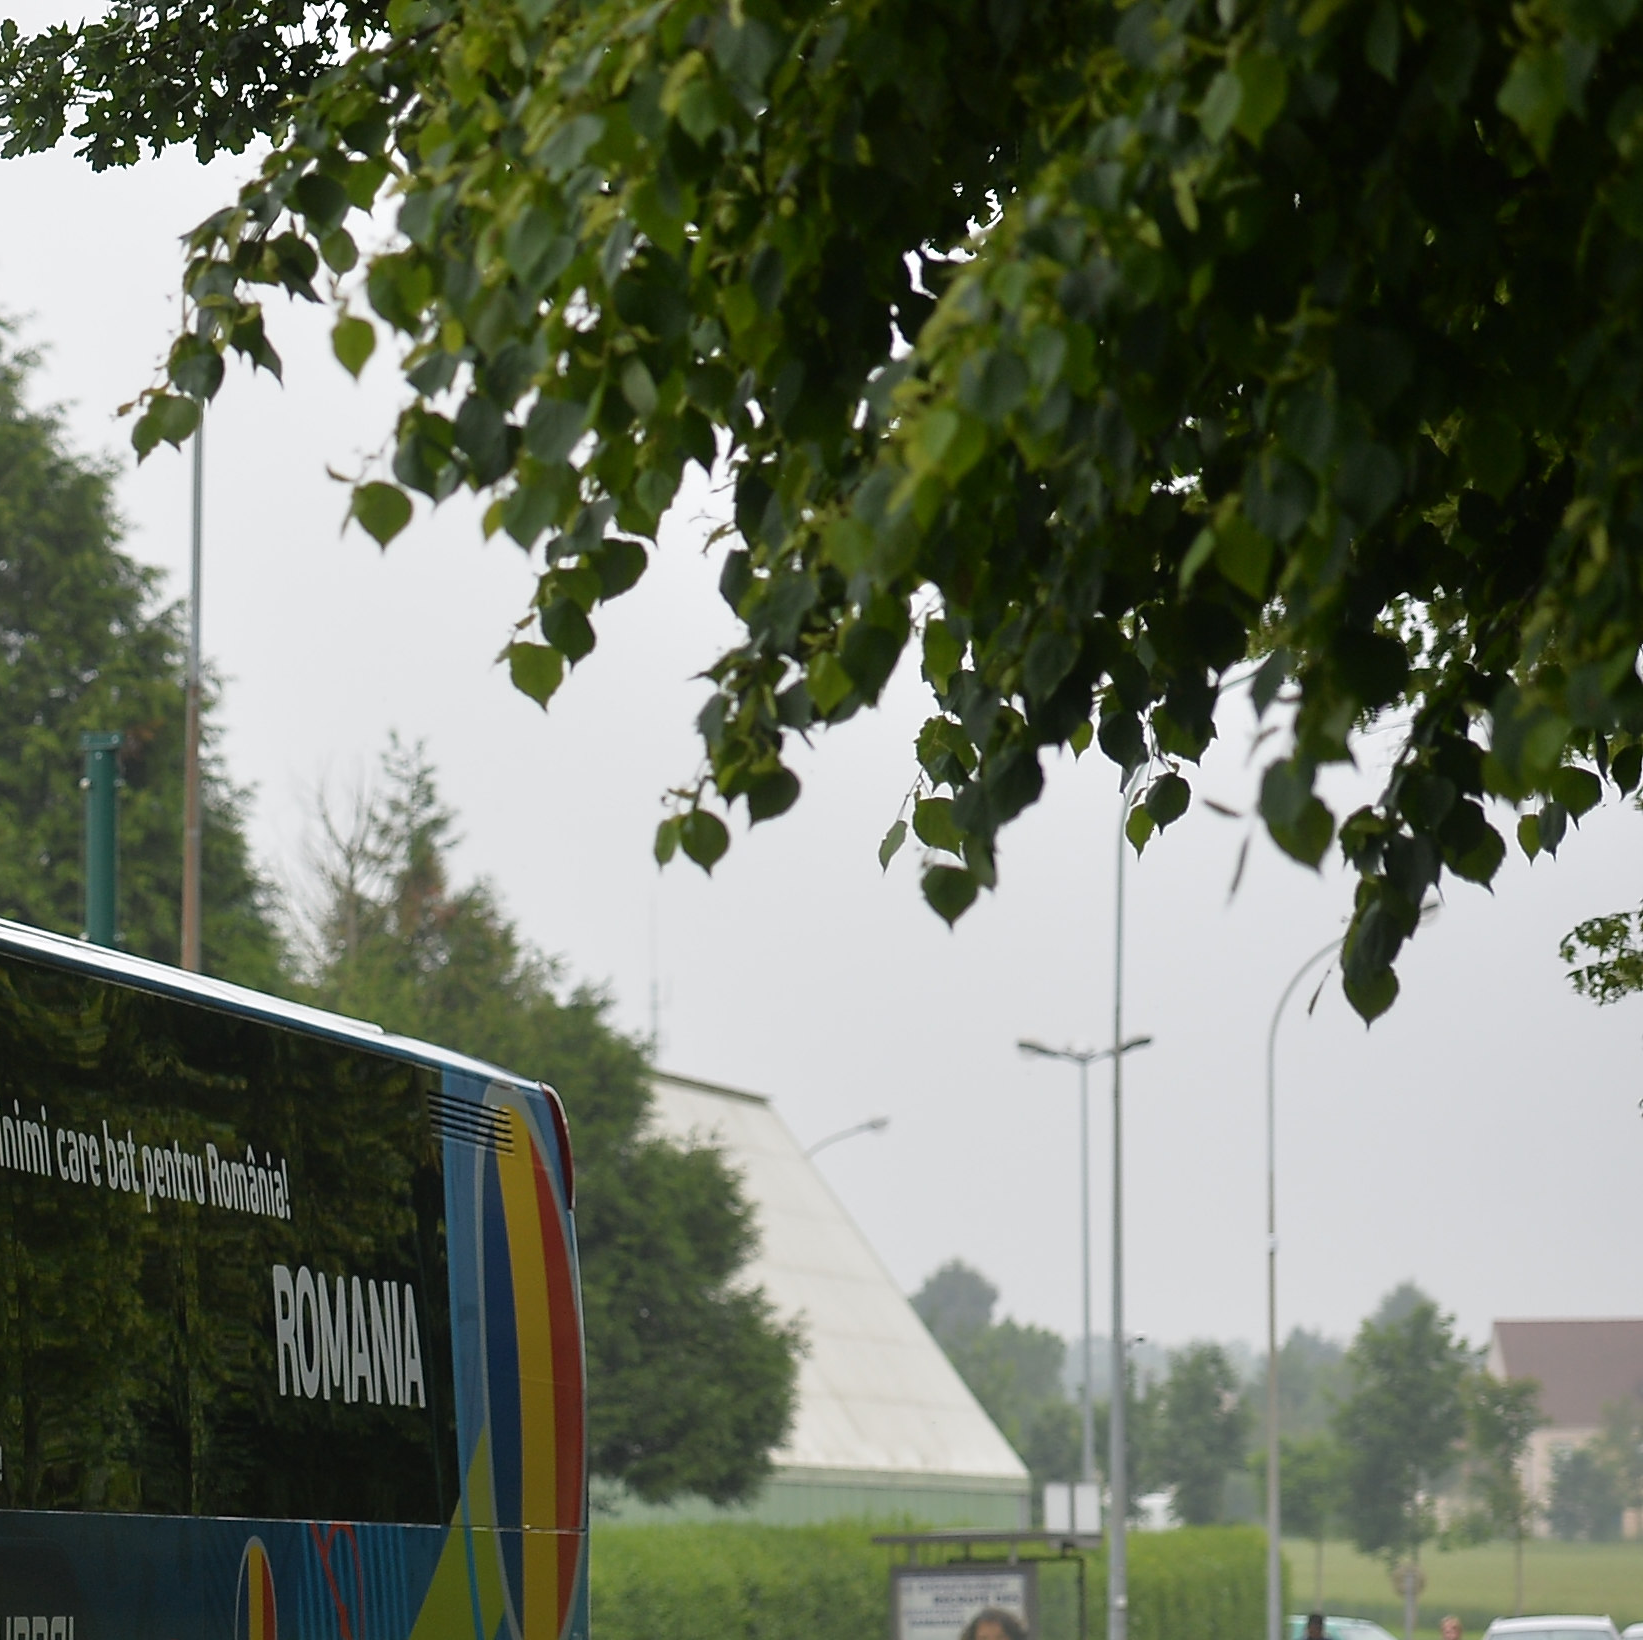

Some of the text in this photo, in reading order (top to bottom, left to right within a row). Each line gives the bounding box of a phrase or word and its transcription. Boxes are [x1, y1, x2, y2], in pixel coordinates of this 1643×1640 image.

[55, 1128, 102, 1187] care
[102, 1119, 141, 1194] bat
[141, 1139, 206, 1213] pentru
[205, 1142, 292, 1220] România!
[272, 1264, 427, 1409] ROMANIA
